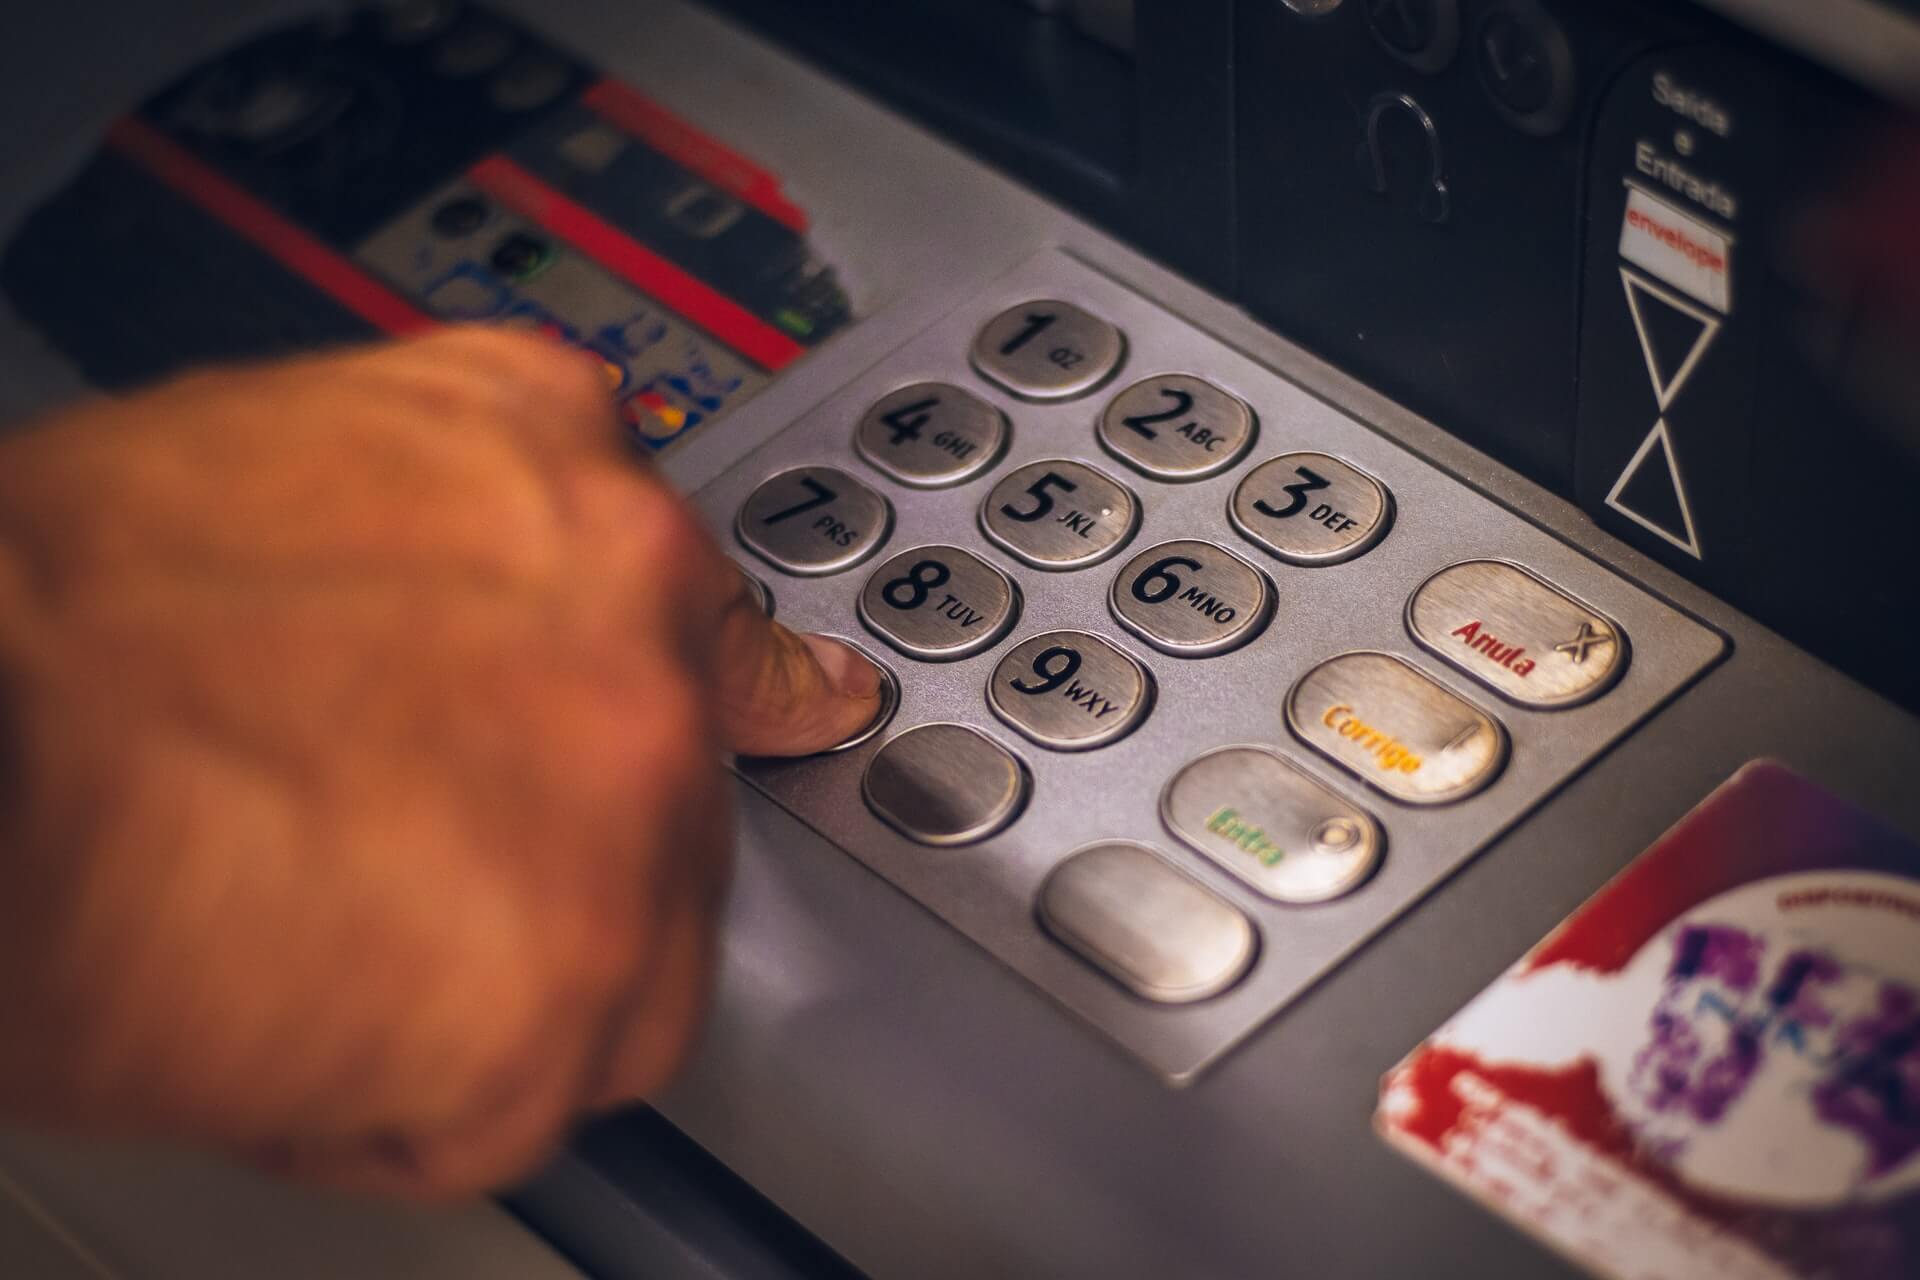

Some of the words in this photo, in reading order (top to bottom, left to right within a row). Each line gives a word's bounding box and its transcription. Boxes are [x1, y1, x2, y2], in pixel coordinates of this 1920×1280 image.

[1636, 141, 1737, 220] Entrada
[1627, 208, 1724, 272] envelope
[1000, 313, 1056, 355] 1
[880, 395, 942, 446] 4
[931, 431, 977, 460] GHI
[1121, 389, 1193, 440] 2
[1176, 422, 1225, 452] ABC
[762, 476, 838, 526] 7
[812, 515, 859, 547] PRS
[1000, 472, 1077, 522] 5
[1056, 509, 1098, 539] JKL
[1253, 466, 1331, 518] 3
[1309, 503, 1359, 535] DEF
[882, 559, 951, 610] 8
[937, 593, 984, 629] TUV
[1131, 555, 1202, 604] 6
[1177, 585, 1236, 625] MNO
[1009, 645, 1082, 695] 9
[1065, 678, 1119, 720] WXY
[1452, 620, 1537, 678] Anula
[1322, 704, 1424, 774] Corrige
[1206, 805, 1284, 868] Entra
